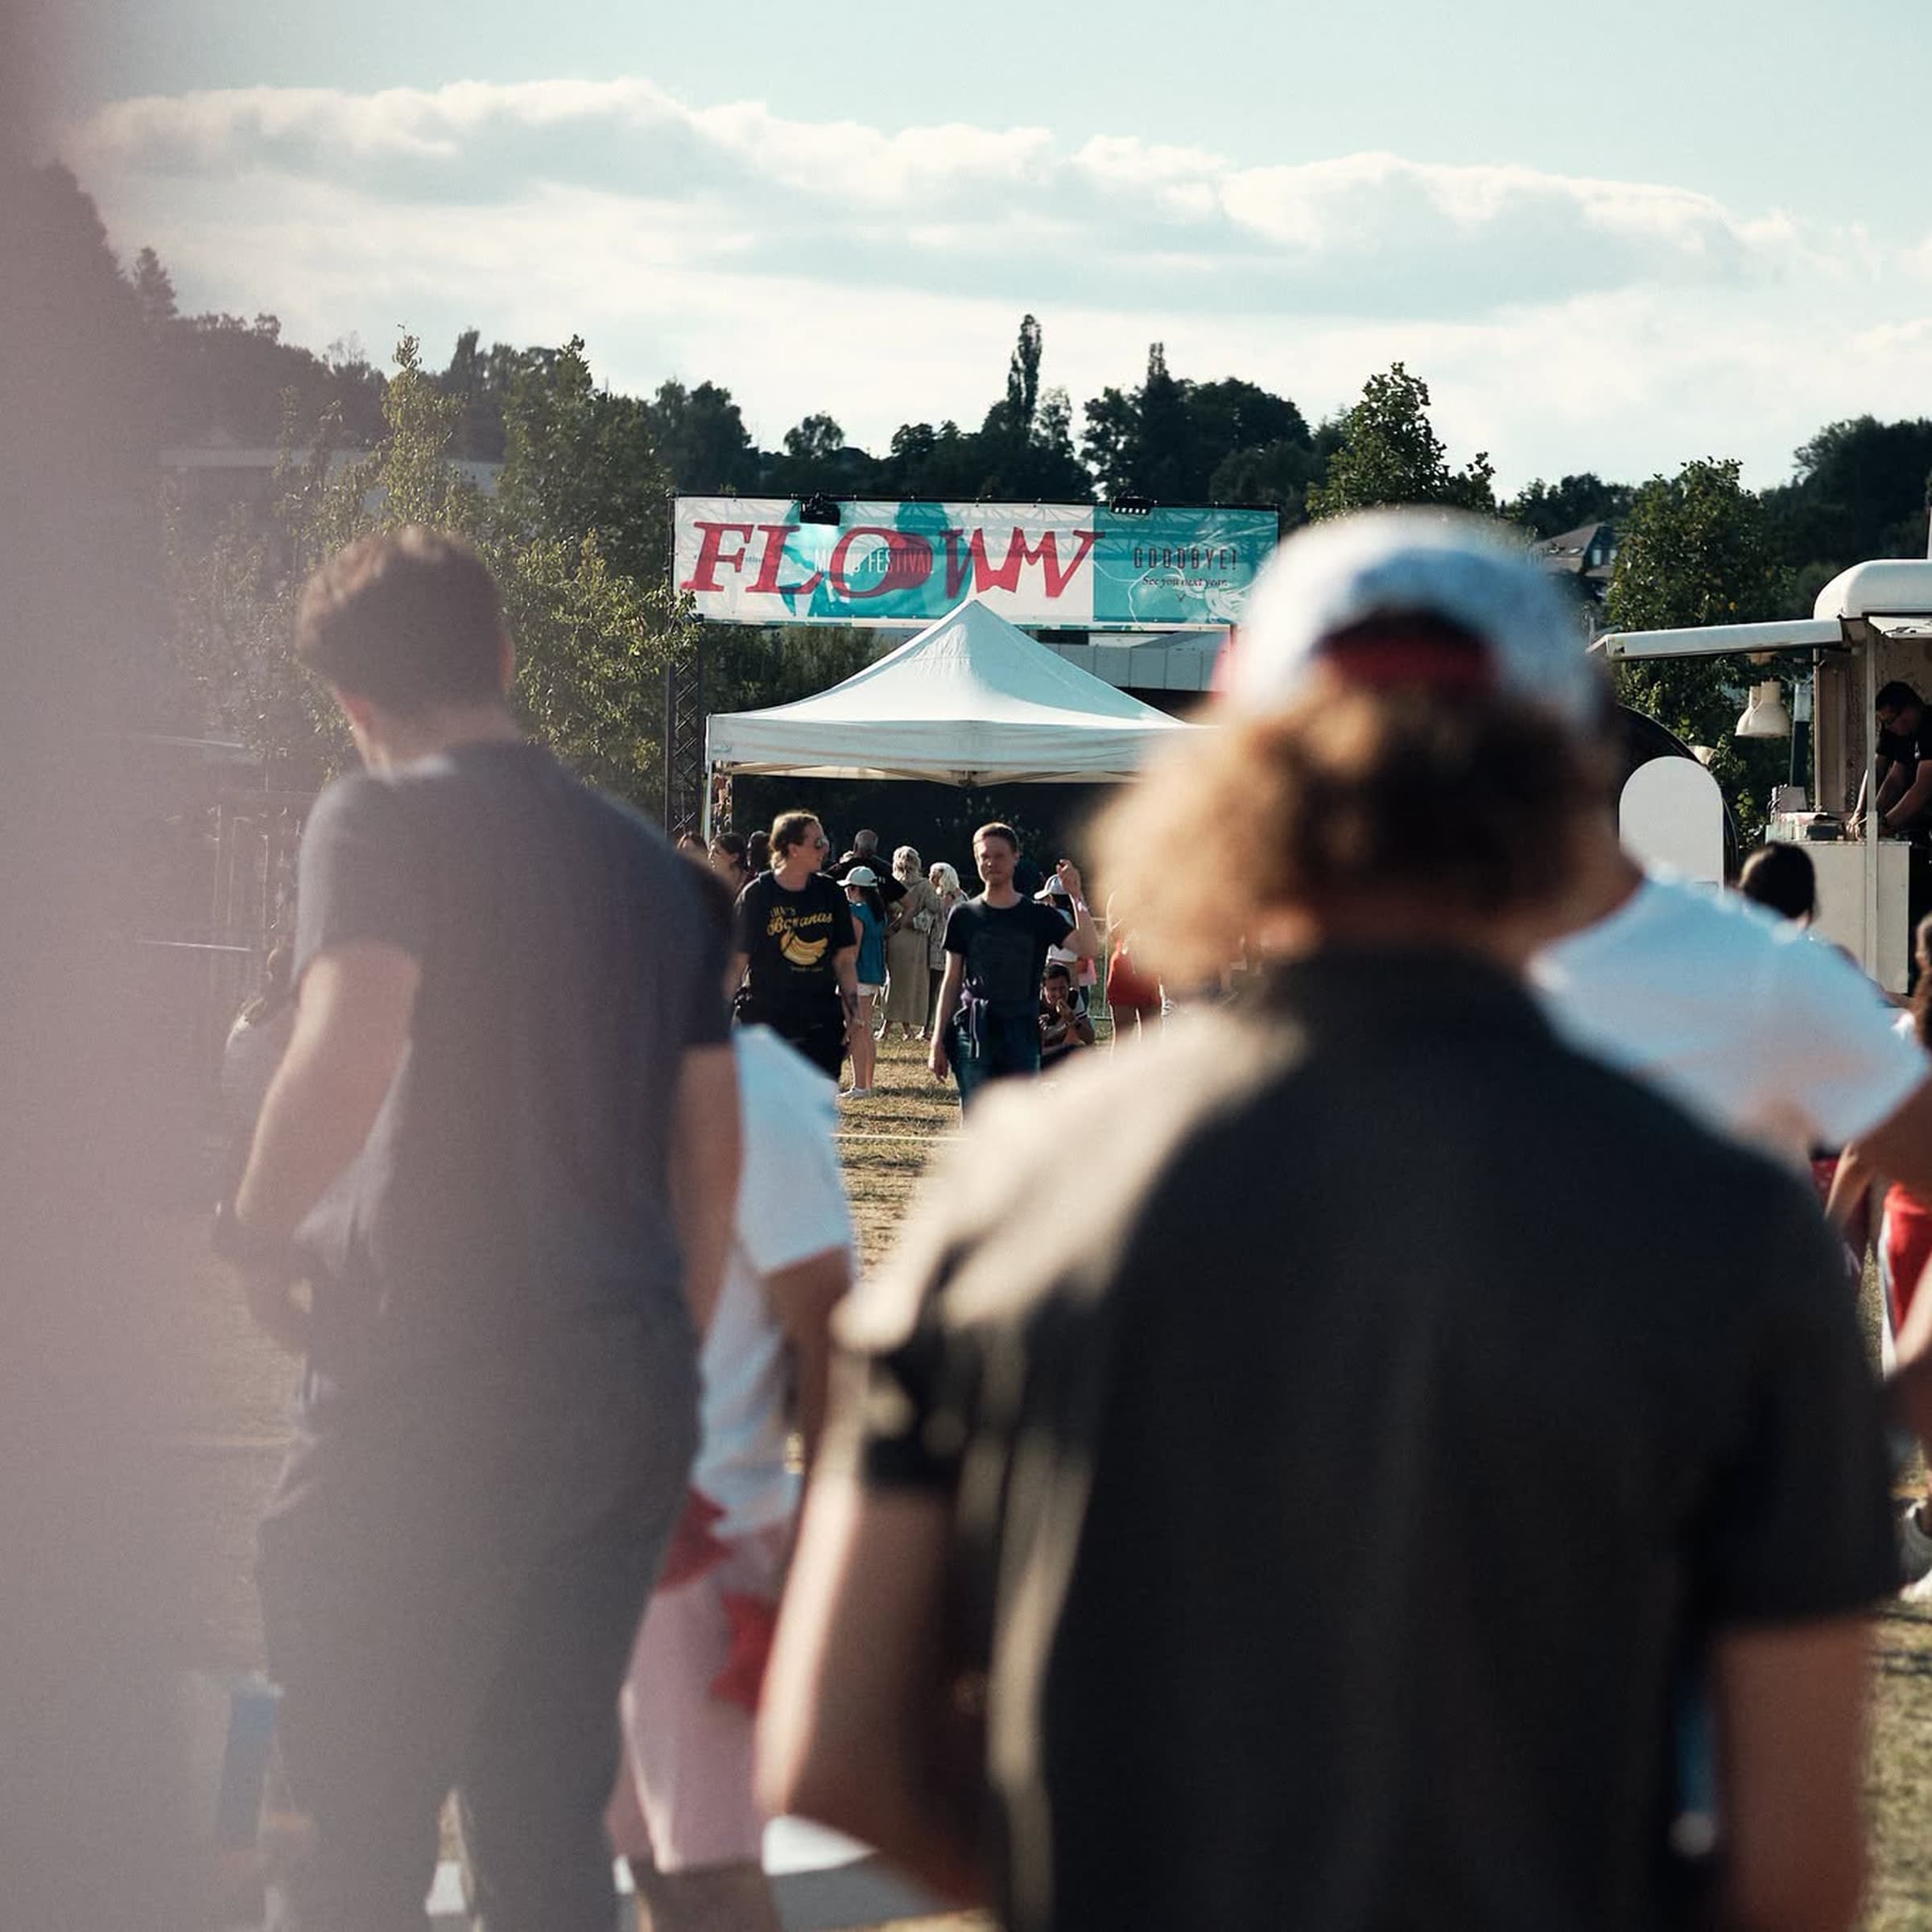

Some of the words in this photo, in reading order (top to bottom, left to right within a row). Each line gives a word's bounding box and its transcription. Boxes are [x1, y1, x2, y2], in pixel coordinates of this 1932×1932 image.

[868, 548, 934, 574] FESTIVAL
[1133, 547, 1237, 571] GOODBYE!
[1141, 575, 1159, 586] See
[1161, 577, 1180, 588] you
[1181, 577, 1203, 587] next
